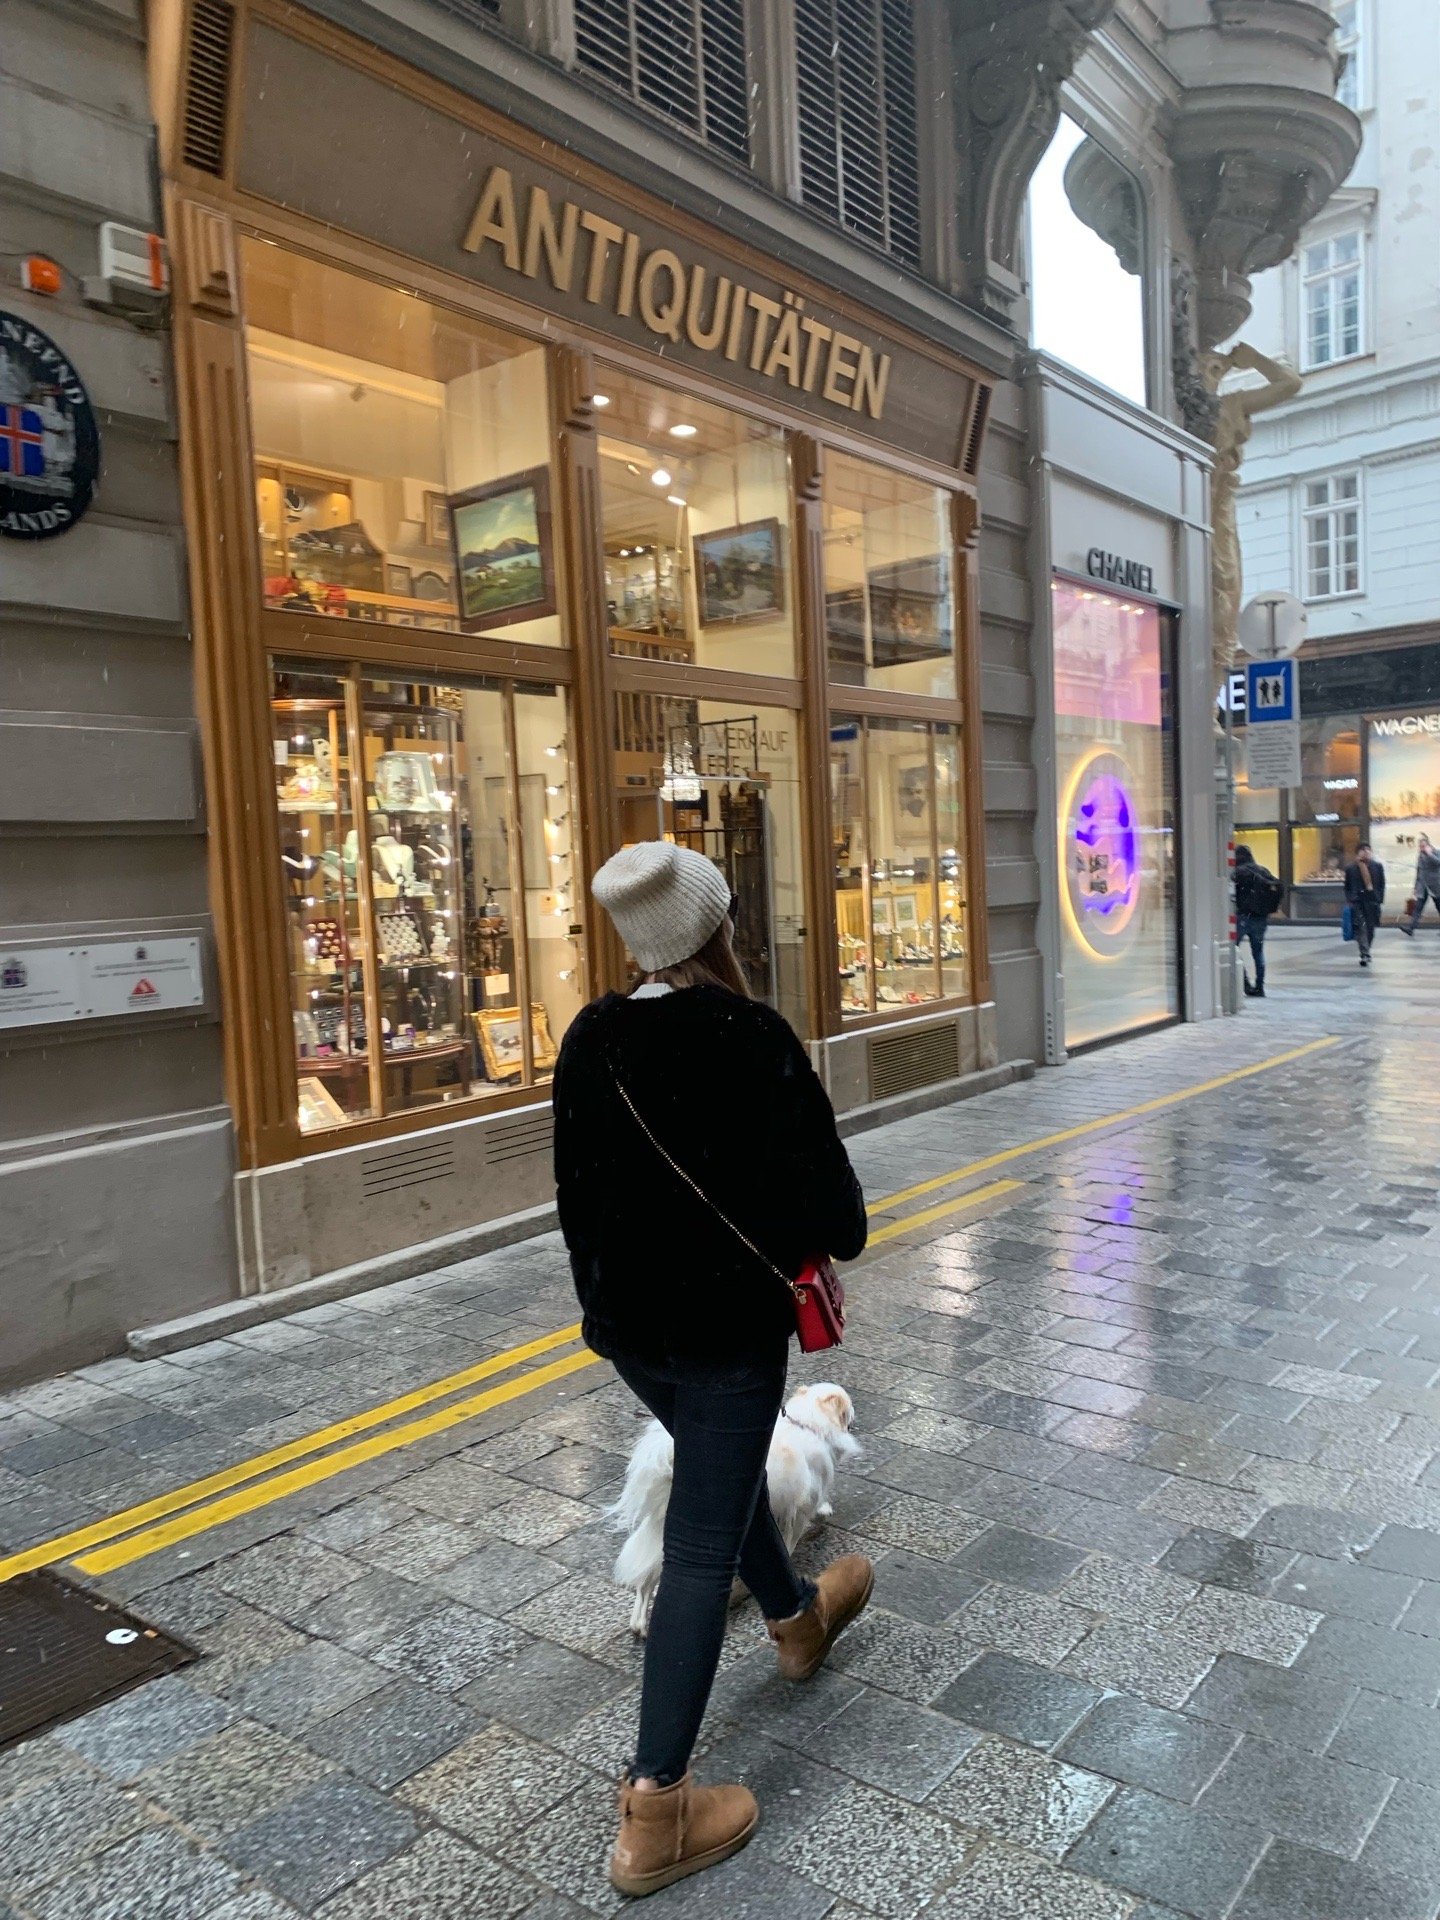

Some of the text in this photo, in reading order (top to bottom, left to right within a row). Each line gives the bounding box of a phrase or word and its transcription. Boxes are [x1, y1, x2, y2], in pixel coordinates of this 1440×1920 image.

[463, 165, 890, 420] ANTIQUITÄTEN
[0, 502, 73, 532] ANDS
[1086, 547, 1158, 595] CHANEL
[1373, 713, 1440, 737] WAGNE
